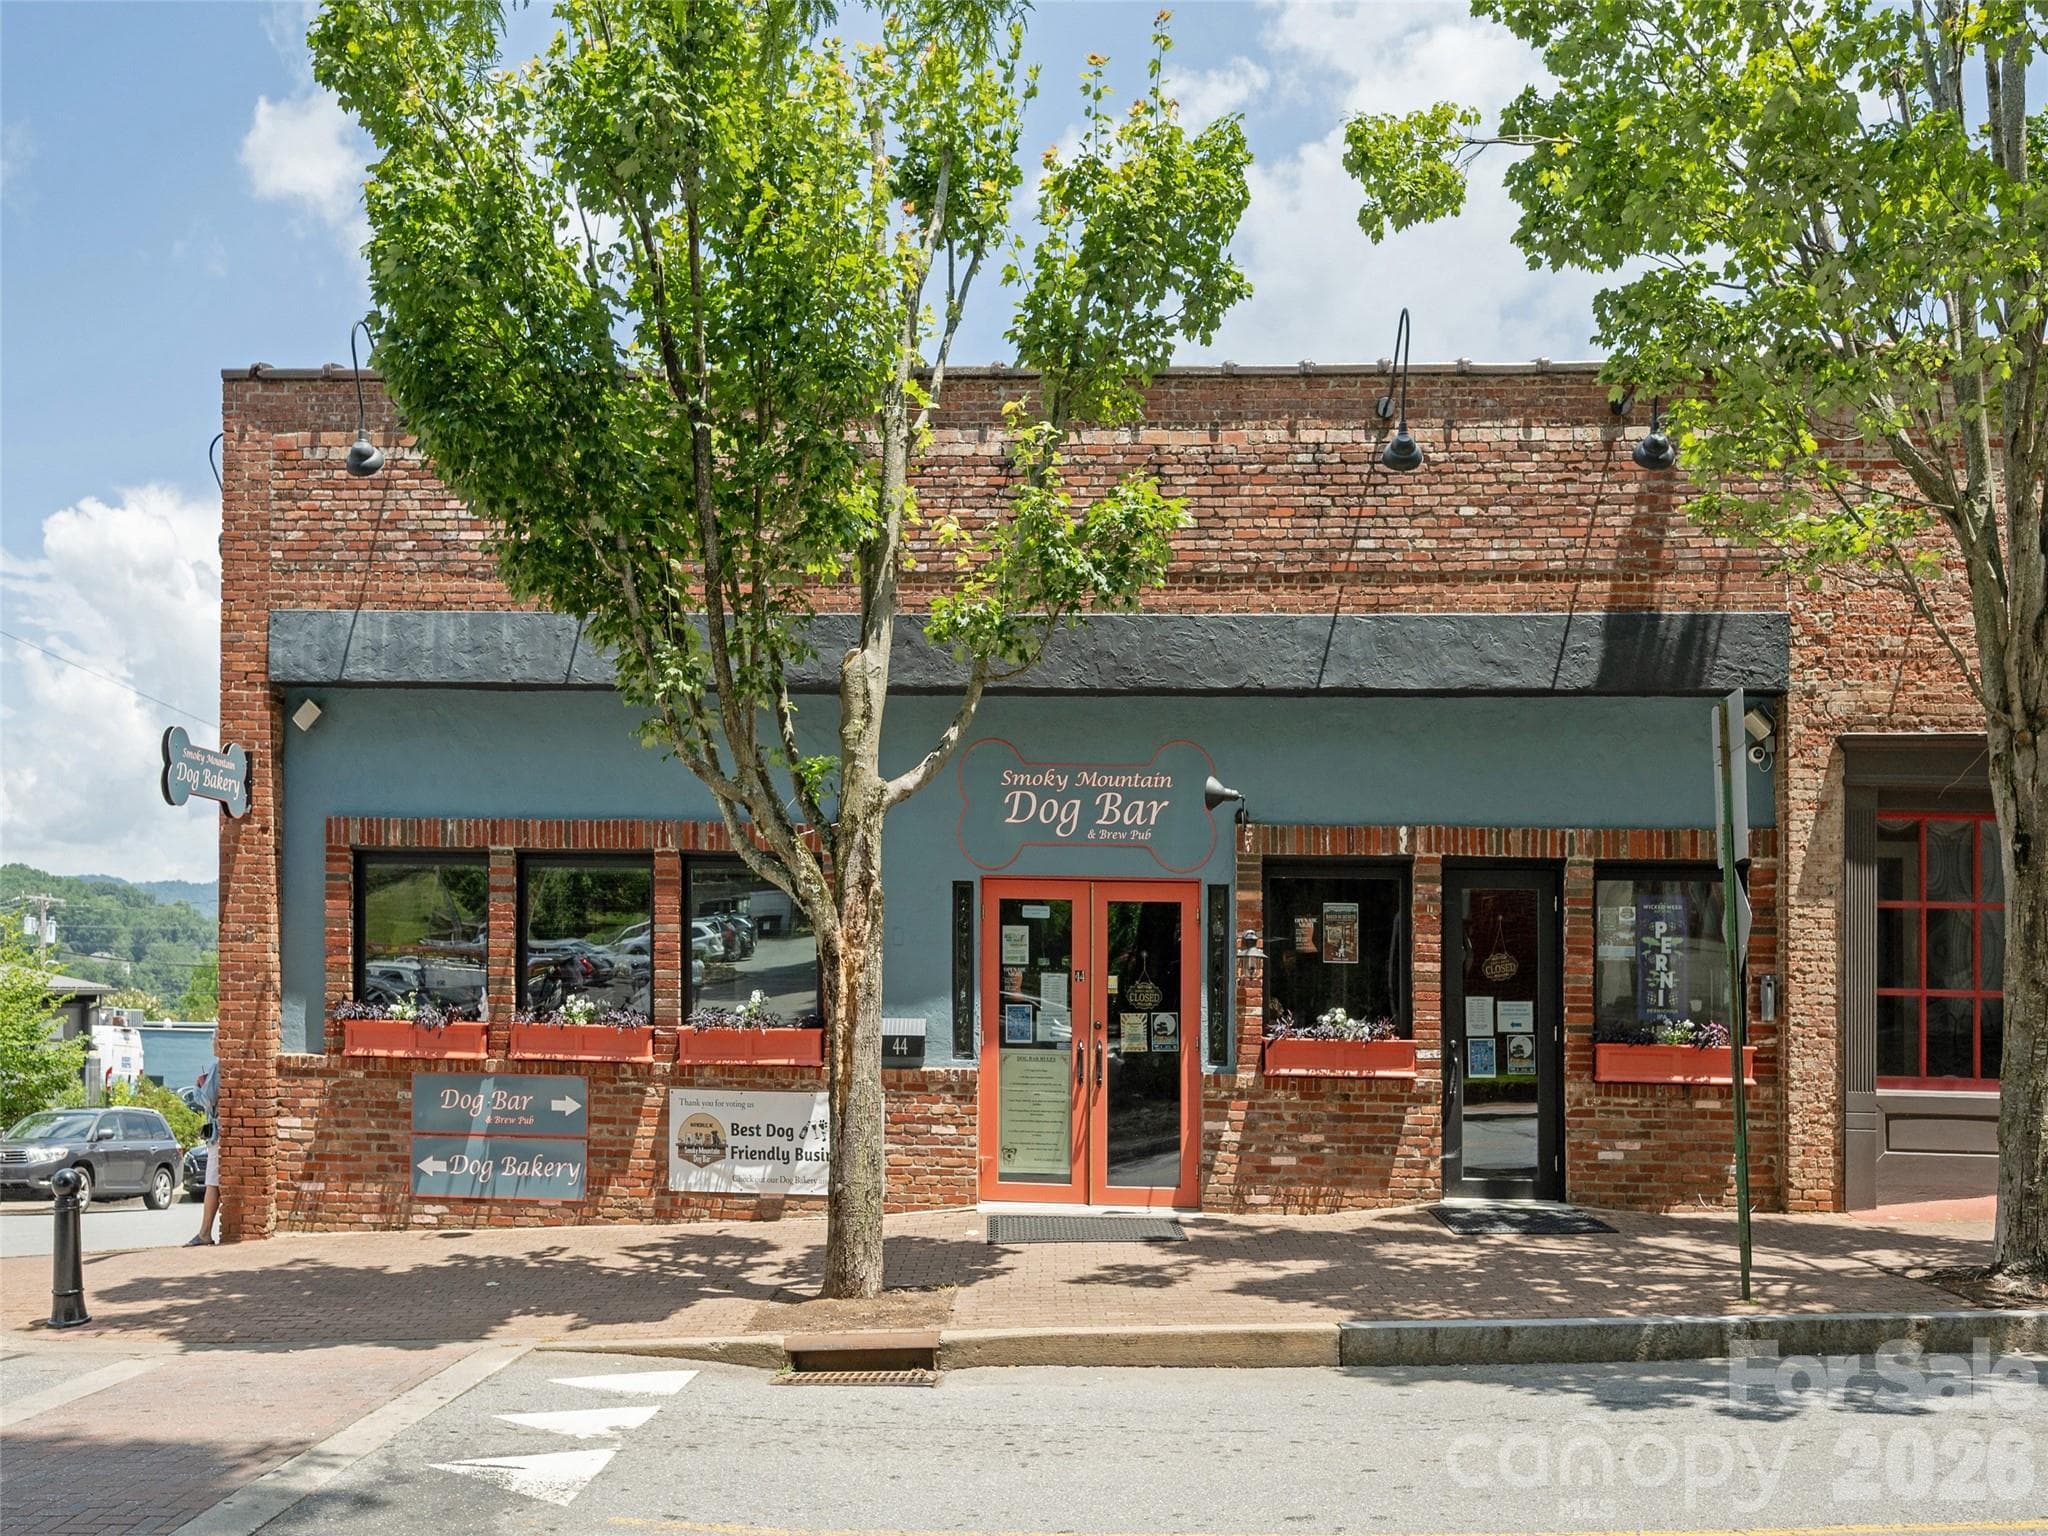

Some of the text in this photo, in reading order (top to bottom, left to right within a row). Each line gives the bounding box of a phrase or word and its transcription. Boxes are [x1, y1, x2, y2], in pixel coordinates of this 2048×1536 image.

[183, 747, 236, 770] Smoky Mountain
[176, 761, 240, 800] Dog Bakery
[1001, 769, 1174, 792] Smoky Mountain
[1004, 790, 1170, 837] Dog Bar
[1087, 829, 1152, 840] & Brew Pub
[1485, 963, 1516, 975] CLOSED
[1655, 921, 1673, 1007] PERNI
[1074, 970, 1085, 982] 44
[1129, 992, 1160, 1003] CLOSED
[892, 1037, 908, 1055] 44
[440, 1089, 533, 1117] Dog Bar
[680, 1098, 699, 1106] Thank
[701, 1101, 713, 1109] you
[715, 1098, 725, 1107] for
[726, 1100, 746, 1109] voting
[485, 1115, 535, 1125] & Brew Pub
[731, 1123, 794, 1141] Best Dog
[731, 1145, 790, 1165] Friendly
[449, 1154, 581, 1186] Dog Bakery
[779, 1175, 793, 1185] Dog
[795, 1176, 817, 1185] Bakery
